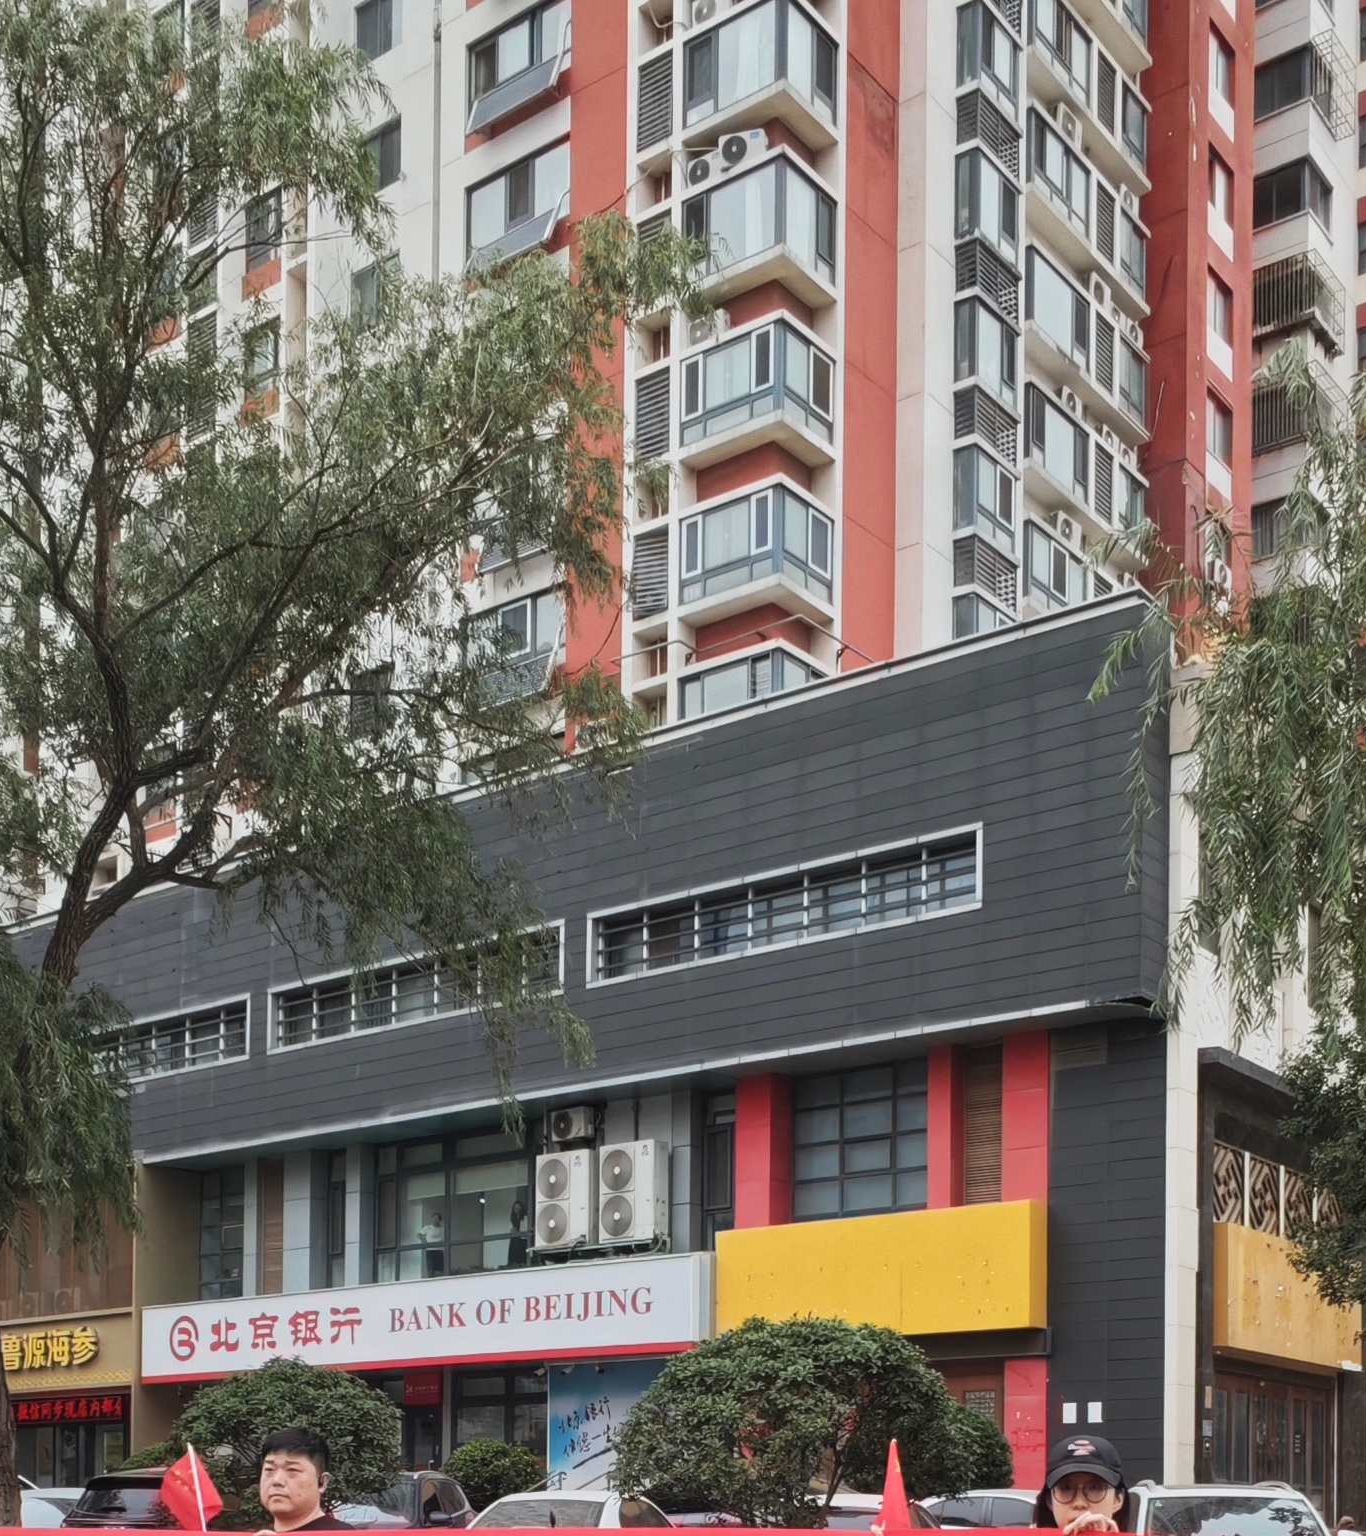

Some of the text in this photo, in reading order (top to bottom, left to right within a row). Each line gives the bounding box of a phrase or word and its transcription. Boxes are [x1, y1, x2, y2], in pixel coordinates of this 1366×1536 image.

[209, 1306, 363, 1353] 北京银行
[388, 1286, 654, 1333] BANK OF BEIJING
[0, 1325, 99, 1371] 鲁源海参
[563, 1423, 617, 1458] 伴您一生
